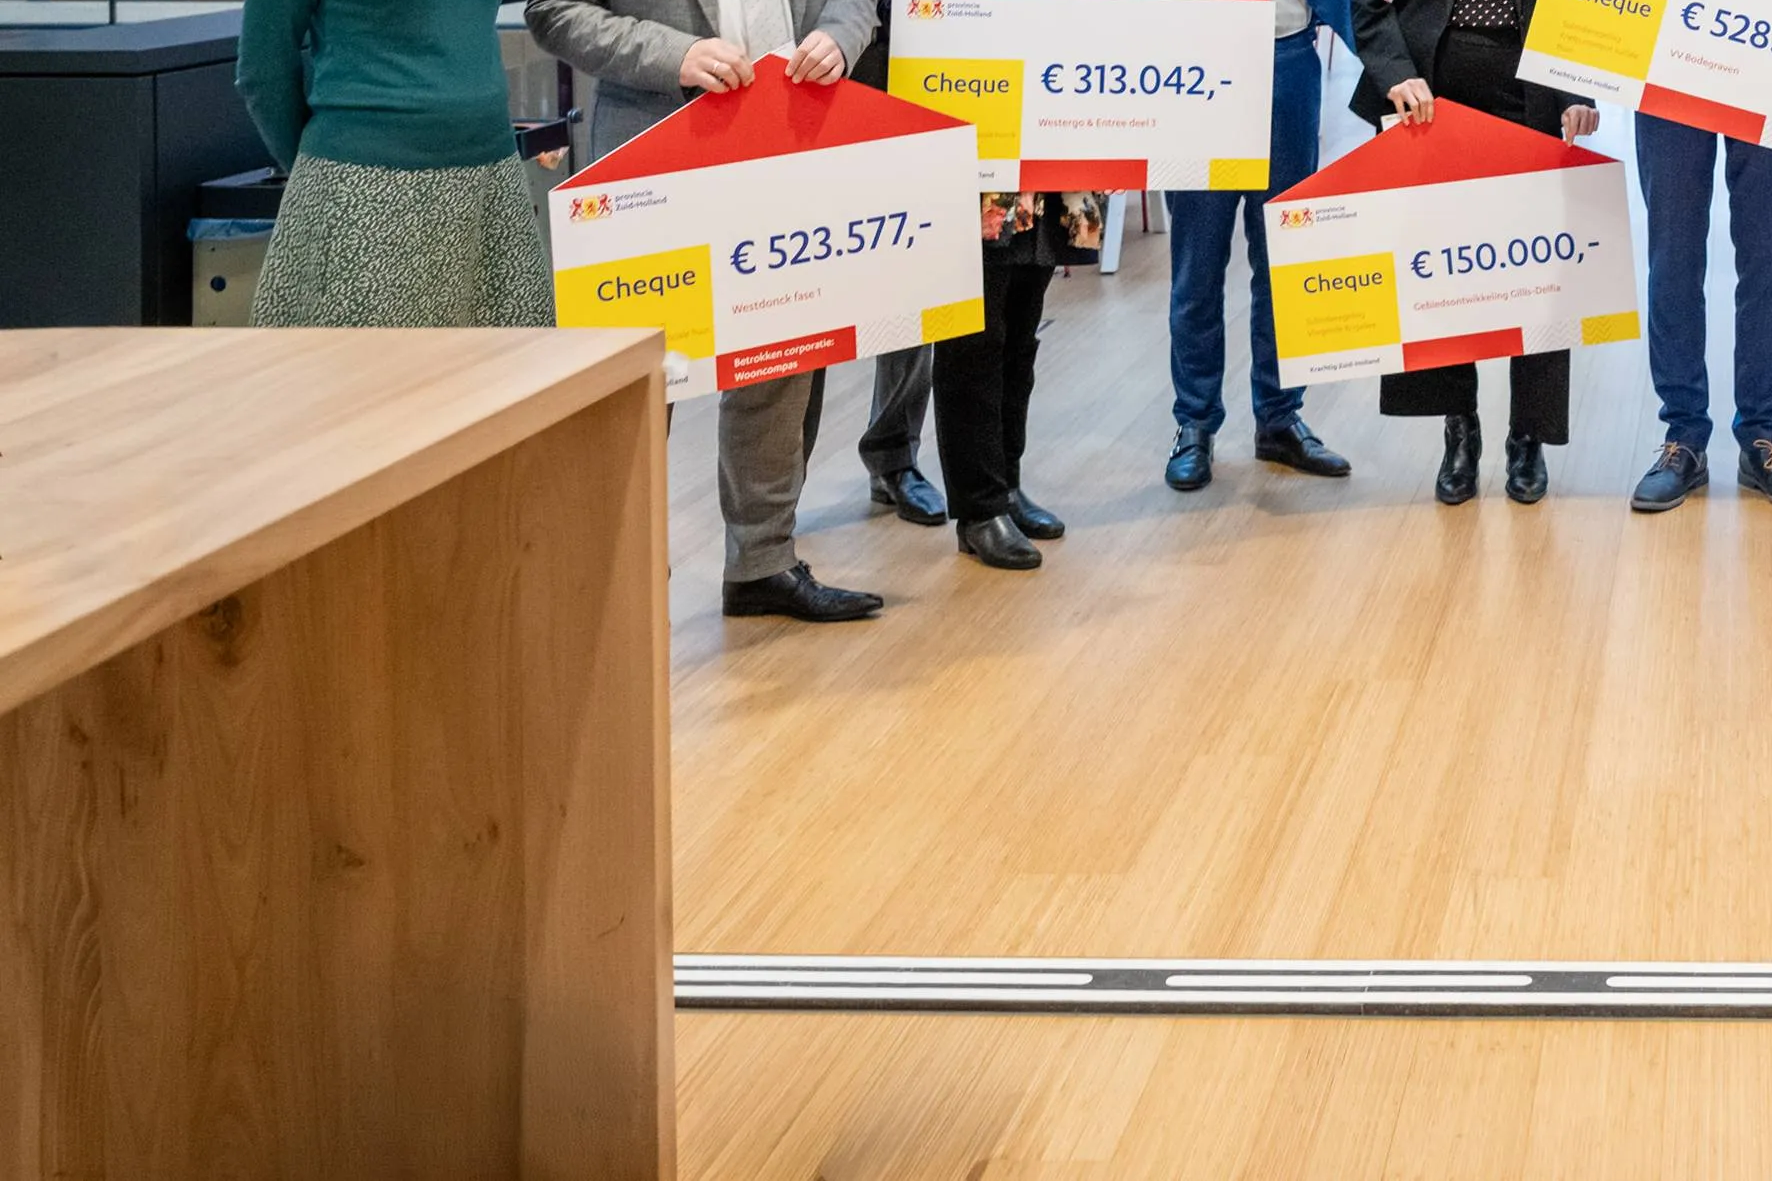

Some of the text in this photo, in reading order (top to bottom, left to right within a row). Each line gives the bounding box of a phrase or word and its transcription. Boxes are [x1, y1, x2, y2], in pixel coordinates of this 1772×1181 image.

[1679, 0, 1705, 31] €
[1669, 48, 1740, 75] VV Bodegraven
[922, 71, 1010, 98] Cheque
[1040, 62, 1232, 101] € 313.042,-
[1085, 117, 1094, 128] &
[729, 210, 932, 275] € 523.577,-
[1409, 231, 1600, 279] € 150.000,-
[595, 269, 696, 302] Cheque
[1302, 271, 1383, 294] Cheque
[730, 292, 791, 315] Westdonck
[792, 290, 815, 302] fase
[732, 337, 835, 369] Betrokken corporatie:
[733, 359, 799, 382] Wooncompas
